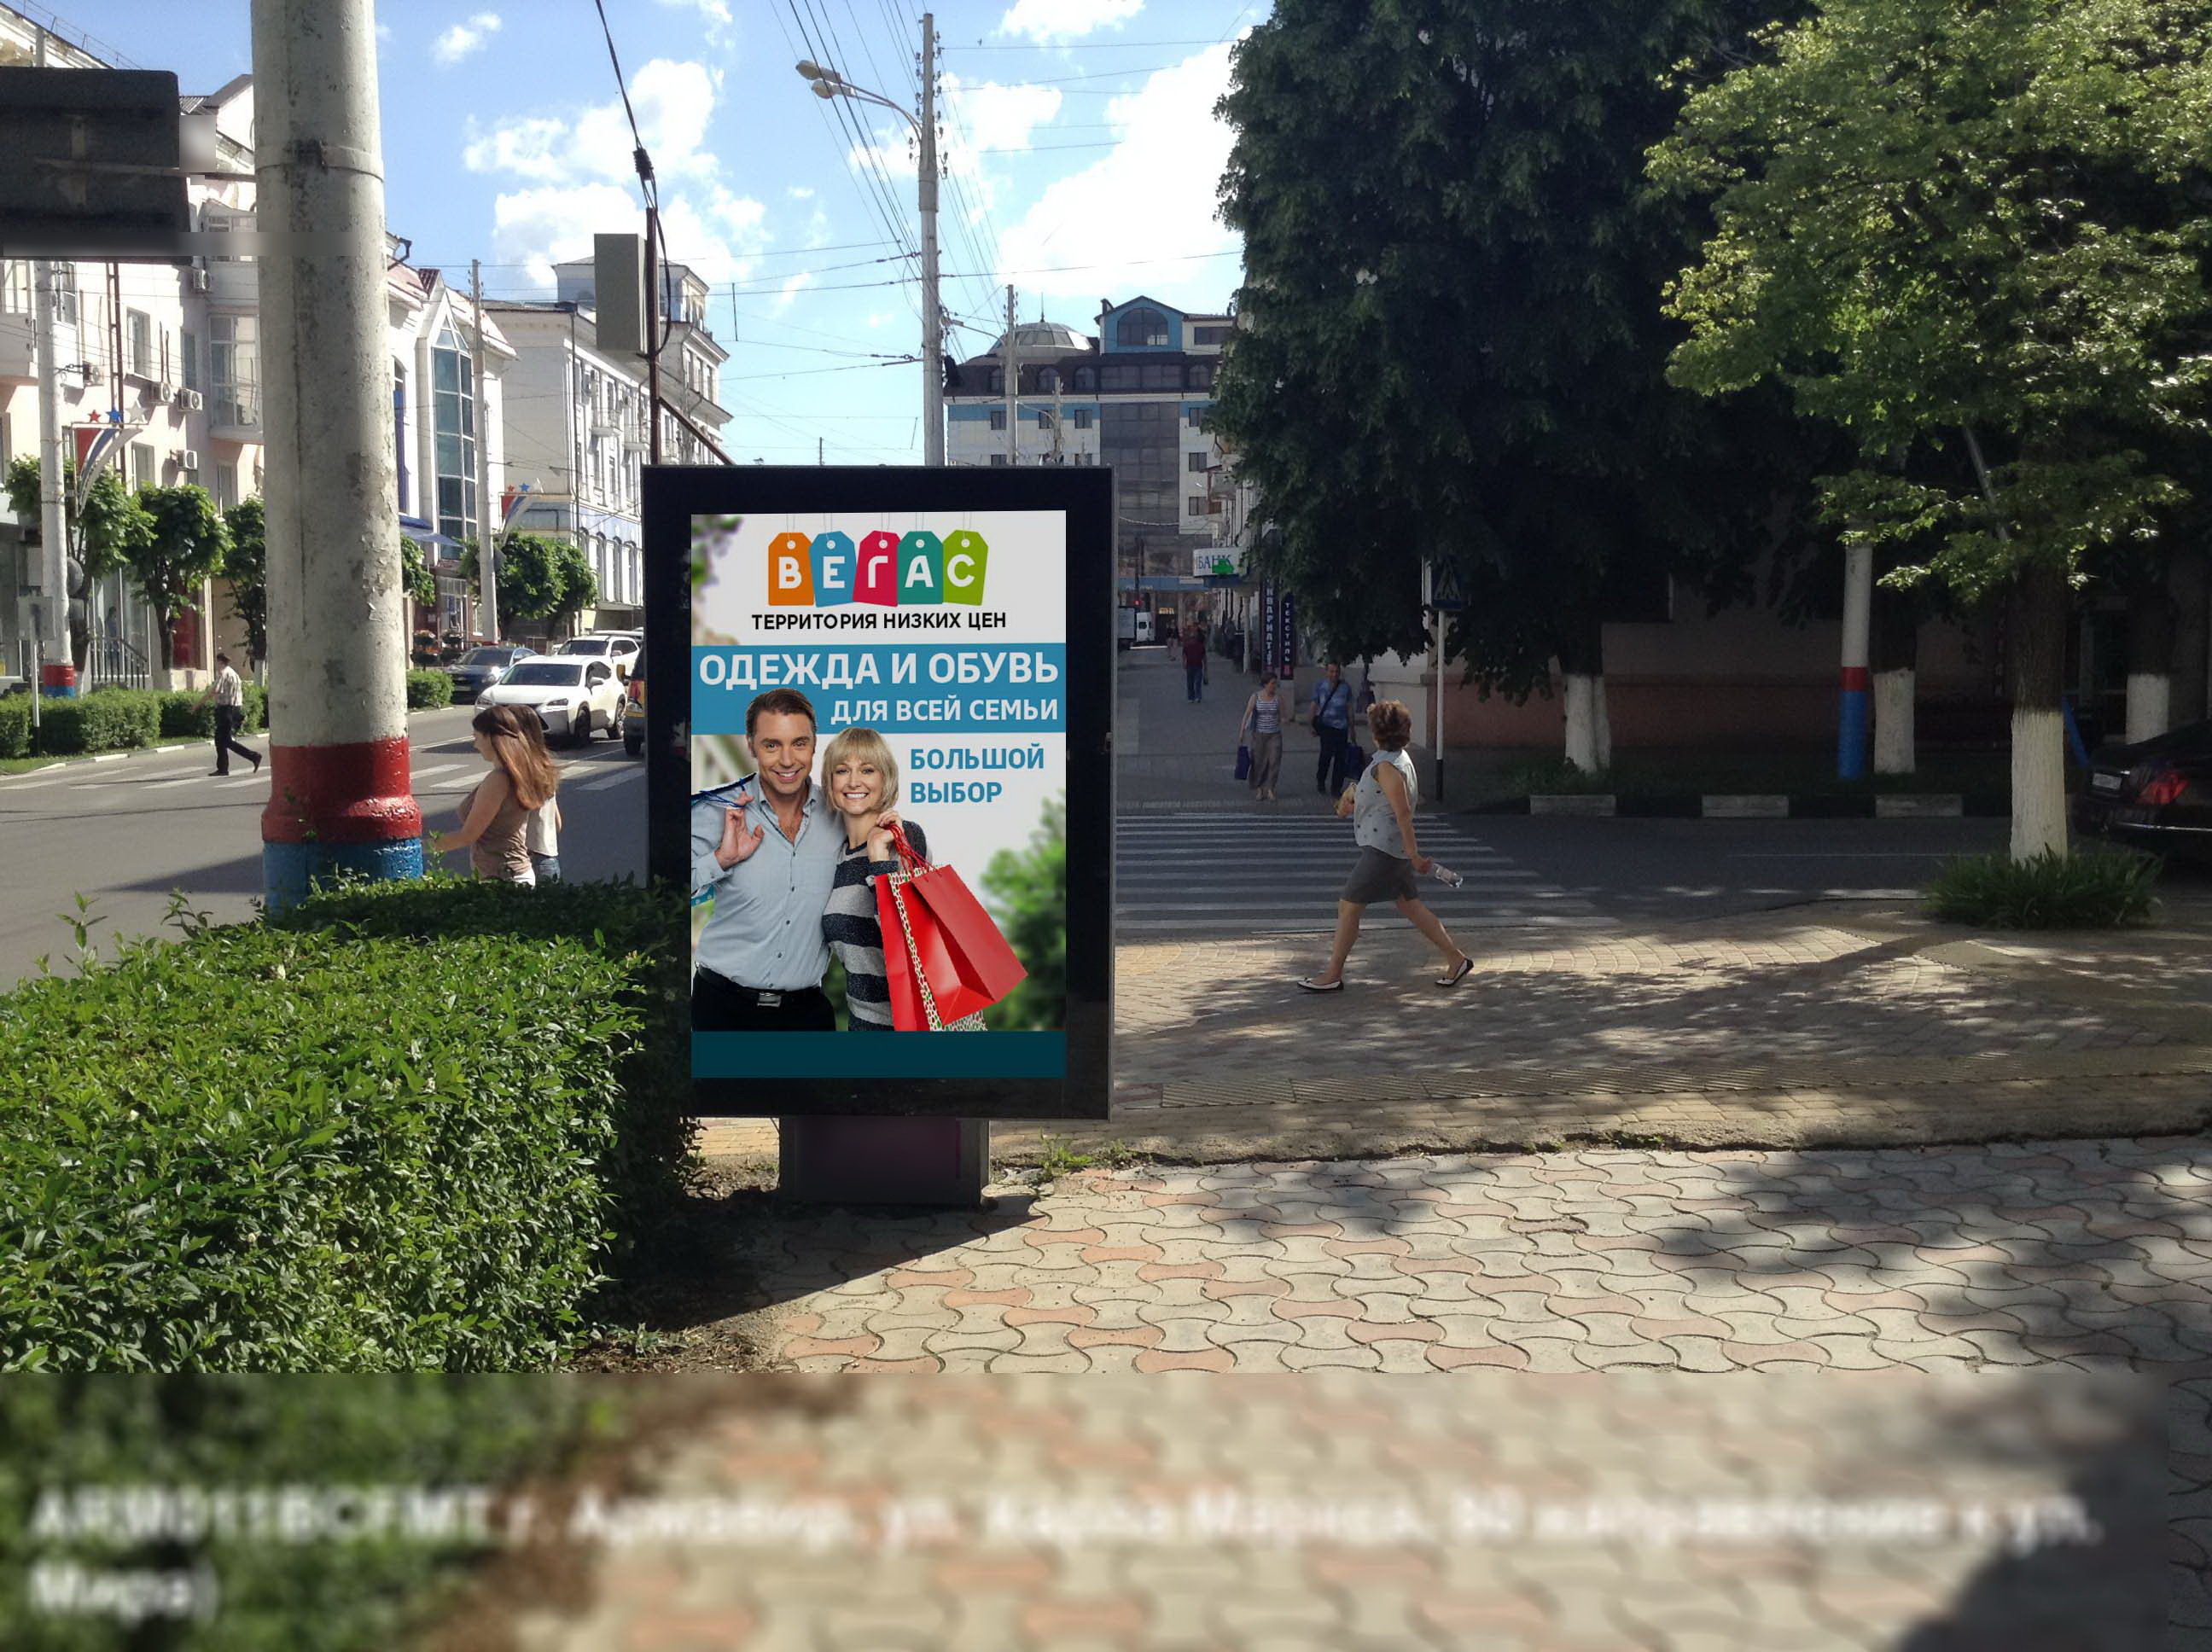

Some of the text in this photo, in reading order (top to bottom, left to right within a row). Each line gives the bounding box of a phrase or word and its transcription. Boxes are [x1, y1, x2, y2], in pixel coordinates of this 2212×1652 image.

[778, 554, 975, 590] ВЕГАС
[751, 612, 1006, 631] ТЕРРИТОРИЯ НИЗКИХ ЦЕН
[699, 651, 1059, 690] ОДЕЖДА И ОБУВЬ
[830, 695, 1058, 725] ДЛЯ ВСЕЙ СЕМЬИ
[910, 742, 1045, 770] БОЛЬШОЙ
[910, 781, 1003, 804] ВЫБОР
